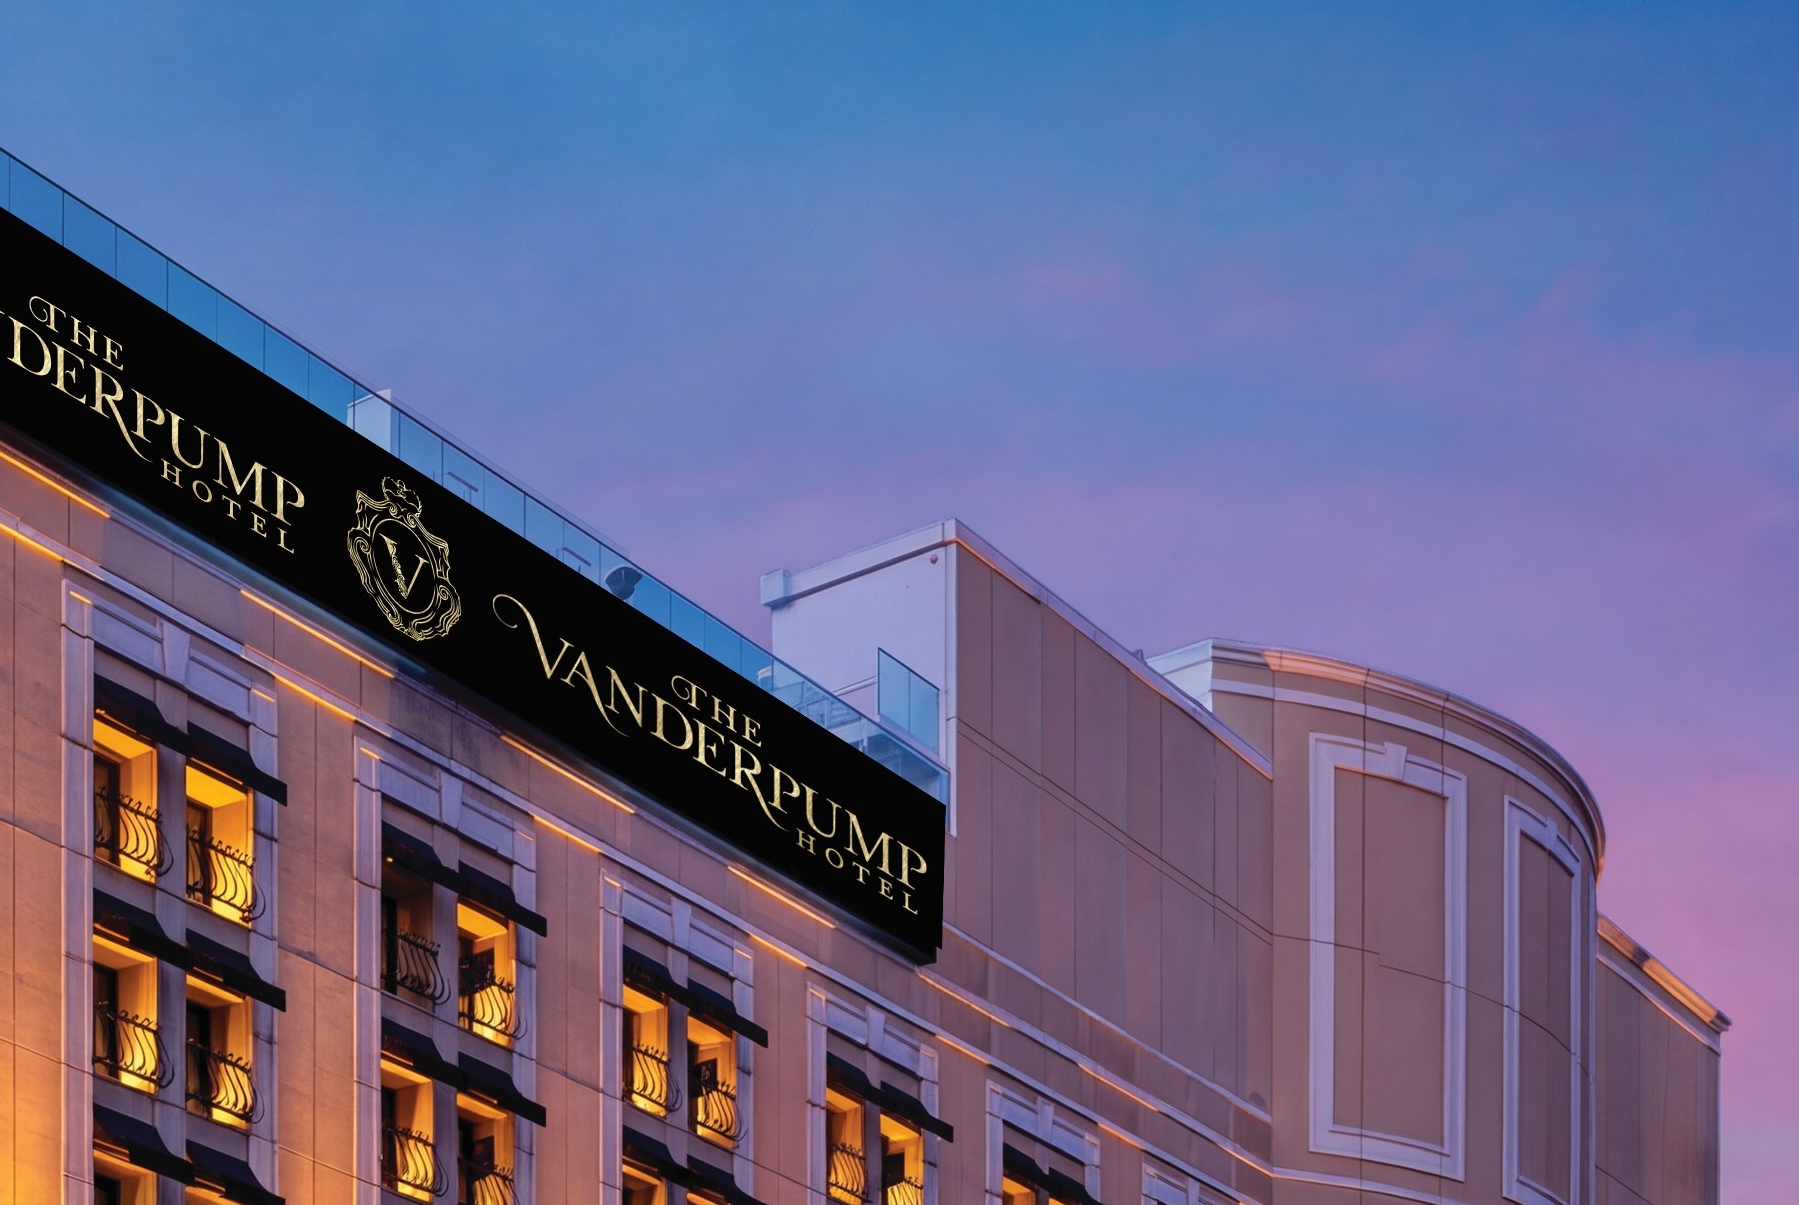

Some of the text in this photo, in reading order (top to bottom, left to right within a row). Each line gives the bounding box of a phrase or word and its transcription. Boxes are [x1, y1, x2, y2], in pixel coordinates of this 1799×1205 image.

[29, 296, 124, 371] THE
[160, 458, 295, 554] HOTEL
[492, 593, 928, 890] VANDERPUMP
[671, 675, 763, 748] THE
[796, 828, 919, 915] HOTEL
